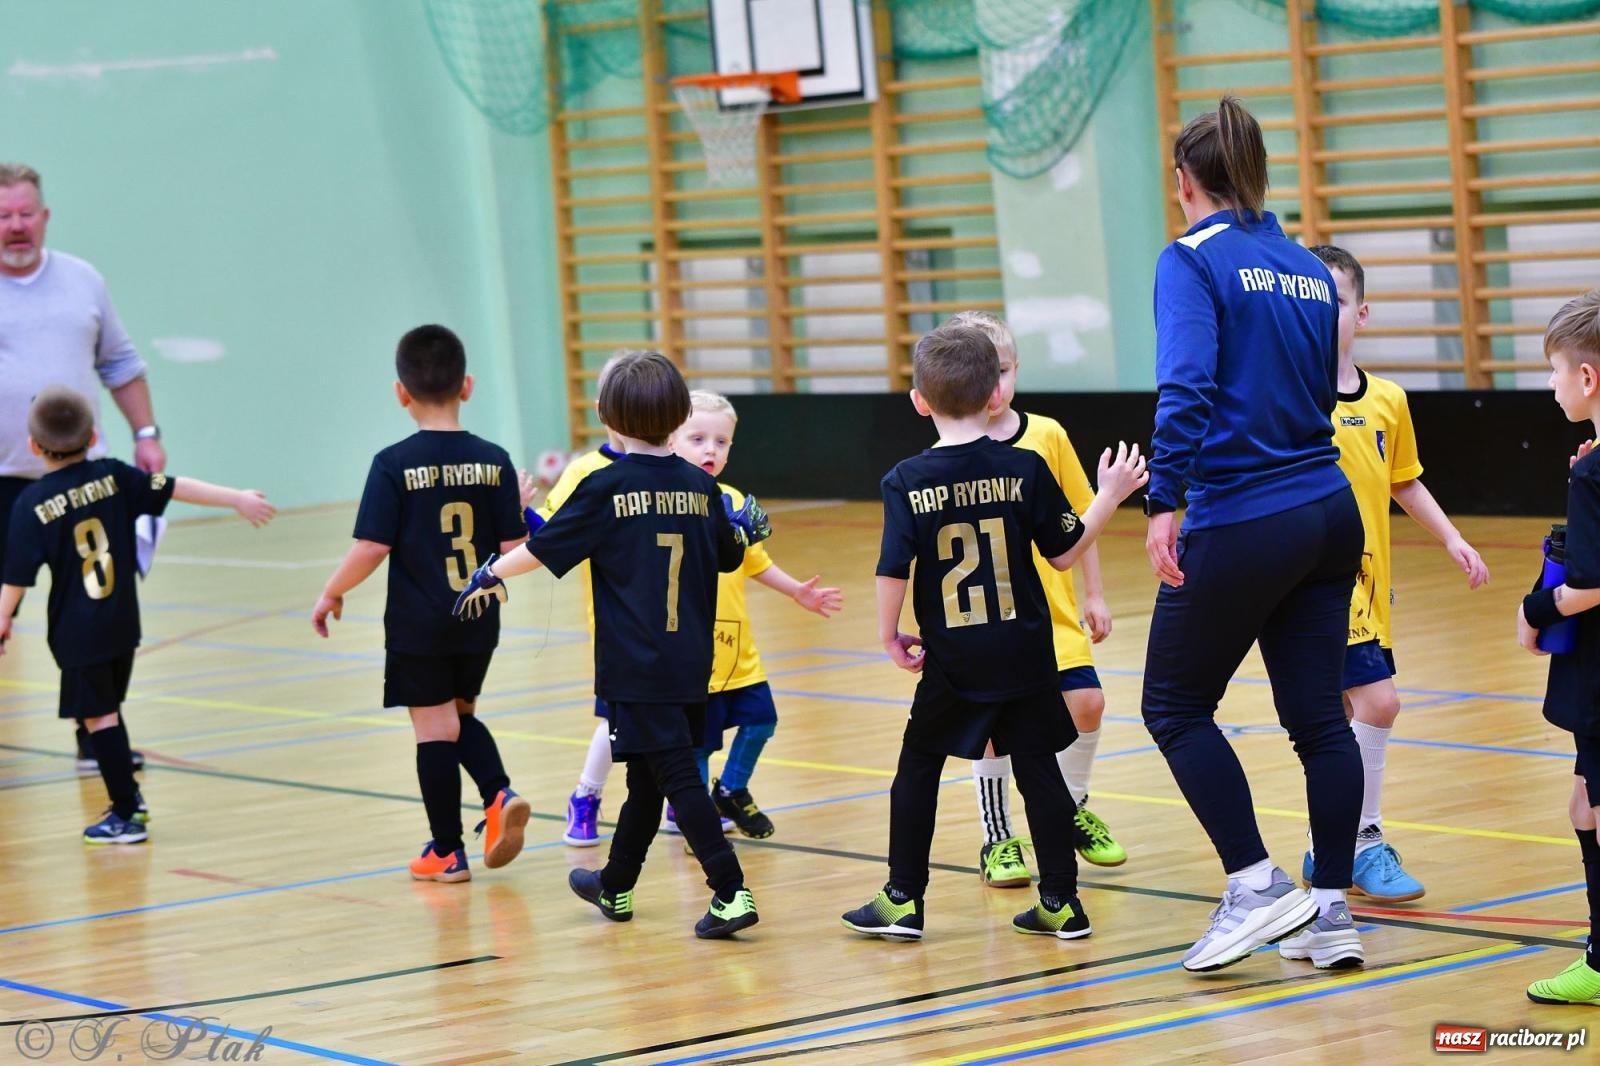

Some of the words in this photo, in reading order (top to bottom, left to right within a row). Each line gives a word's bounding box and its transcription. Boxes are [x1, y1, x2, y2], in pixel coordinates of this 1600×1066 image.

[1238, 267, 1276, 293] RAP
[404, 465, 439, 491] RAP
[442, 462, 501, 487] RYBNIK
[908, 485, 949, 515] RAP
[953, 476, 1024, 508] RYBNIK
[34, 493, 68, 525] RAP
[613, 491, 652, 519] RAP
[655, 491, 710, 518] RYBNIK
[73, 516, 115, 600] 8
[440, 501, 478, 593] 3
[656, 533, 684, 632] 7
[936, 517, 1017, 629] 21
